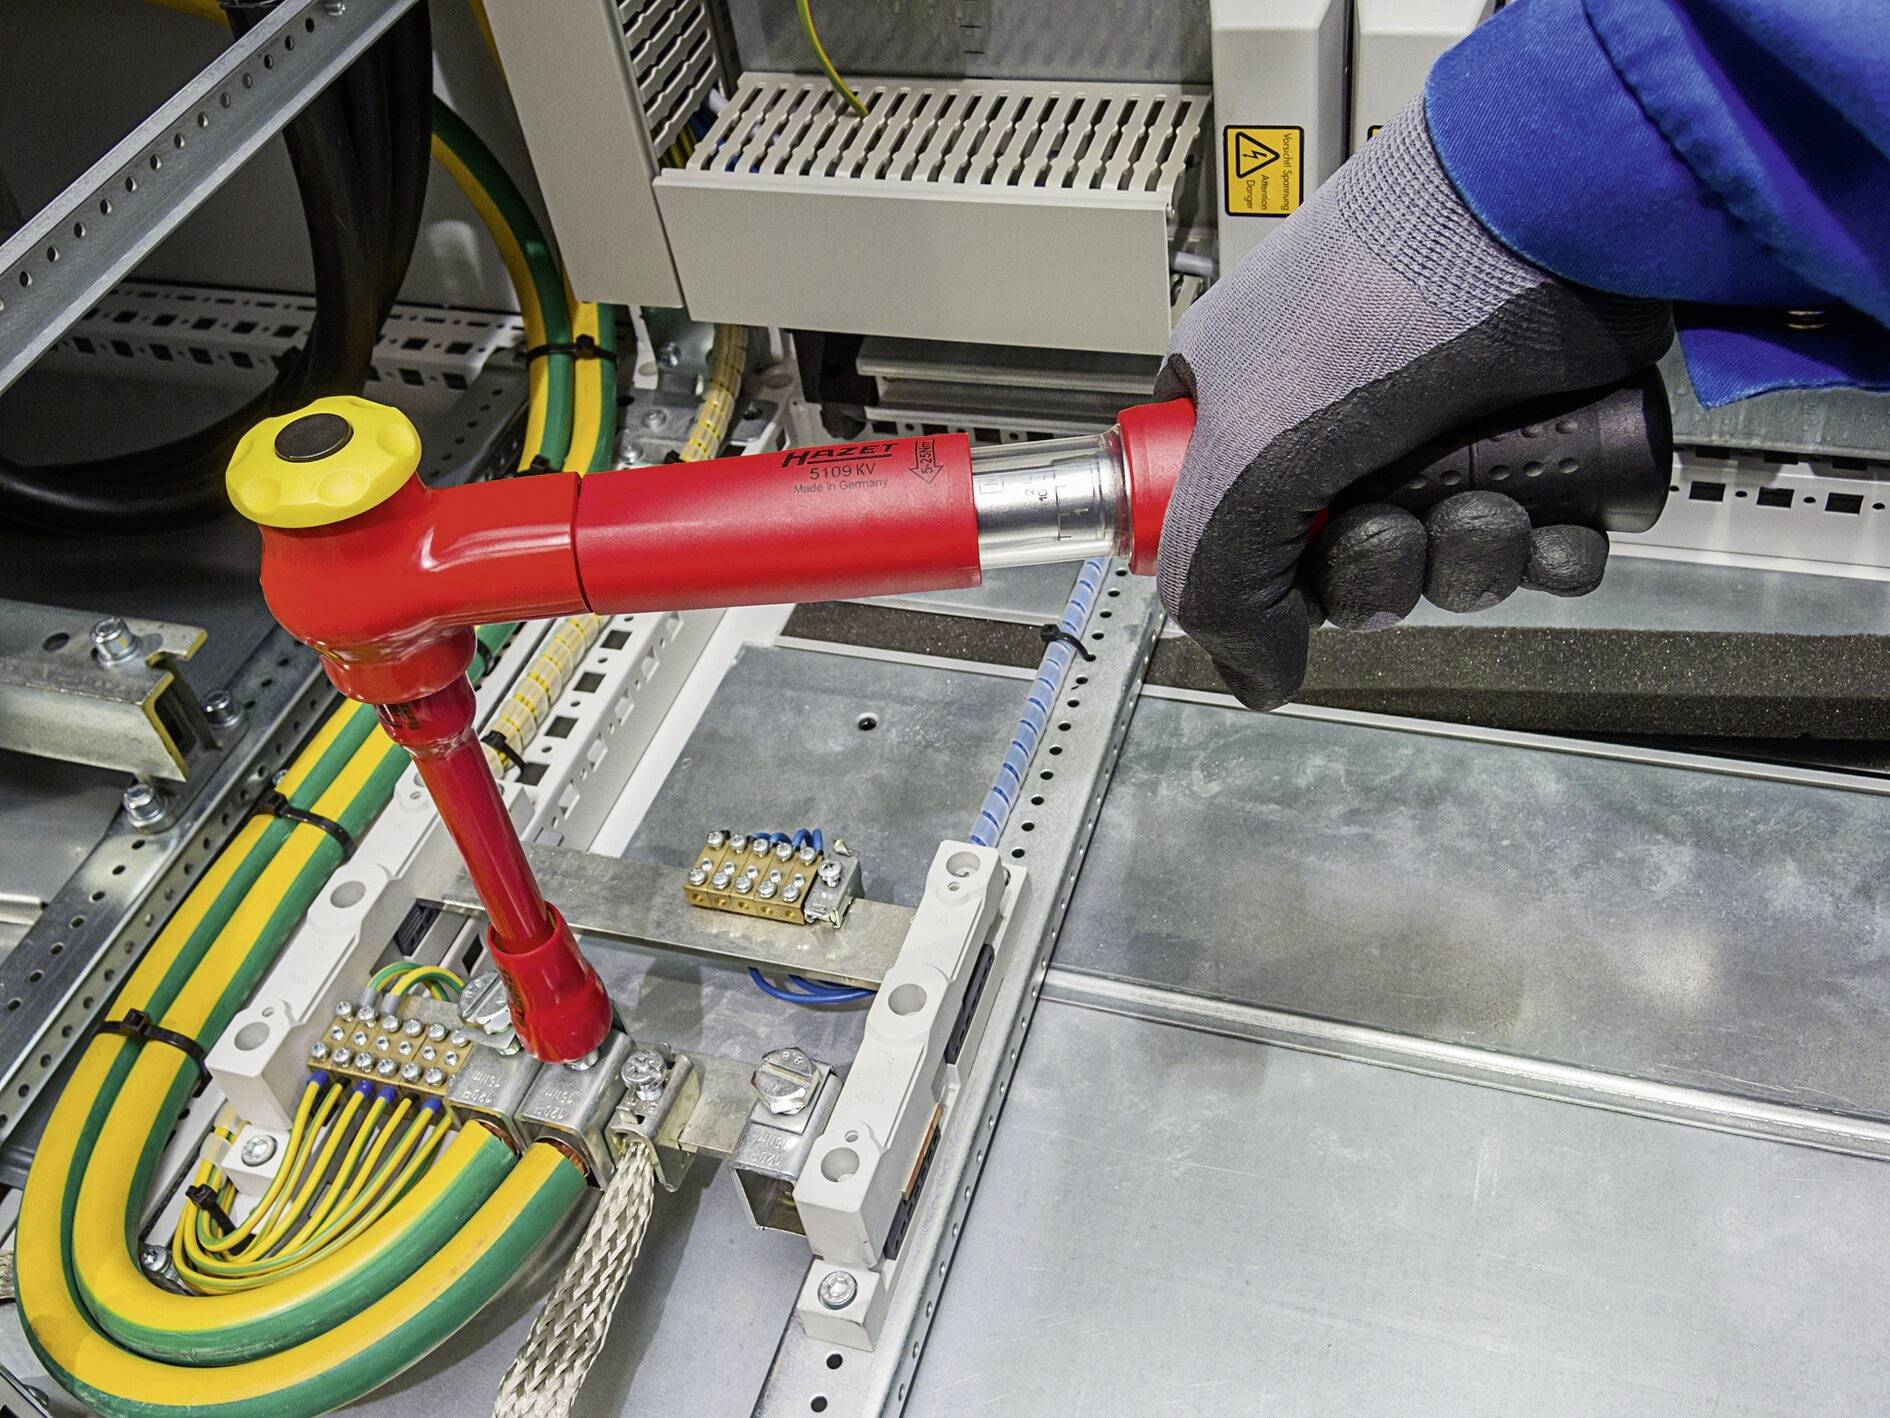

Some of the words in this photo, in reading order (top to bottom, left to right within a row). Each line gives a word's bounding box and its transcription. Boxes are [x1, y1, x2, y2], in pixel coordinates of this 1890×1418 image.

[1283, 132, 1292, 167] Vorsicht!
[1244, 179, 1255, 209] Danger
[1261, 174, 1270, 210] Attention
[1281, 170, 1292, 211] Spannung
[781, 443, 899, 468] HAZET
[809, 466, 852, 480] 5109
[856, 462, 876, 476] KV
[793, 482, 823, 495] Made
[839, 478, 889, 490] Germany
